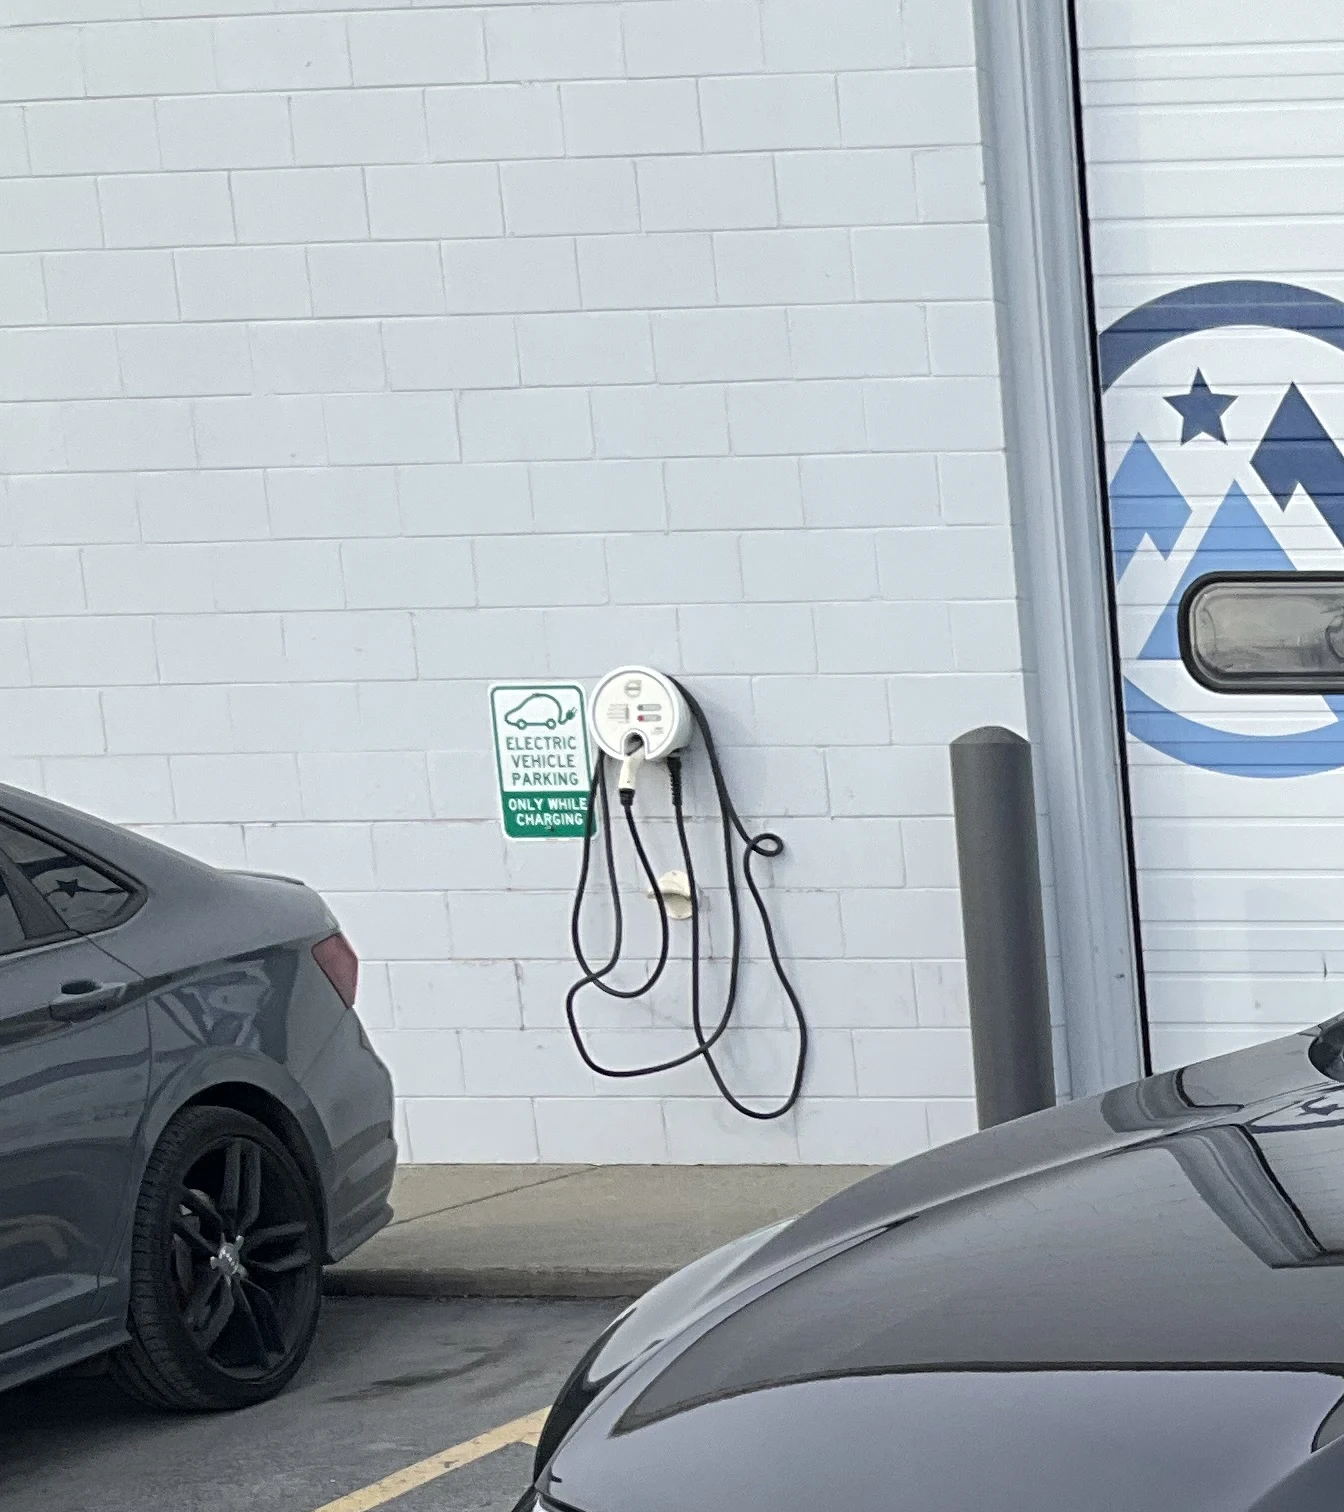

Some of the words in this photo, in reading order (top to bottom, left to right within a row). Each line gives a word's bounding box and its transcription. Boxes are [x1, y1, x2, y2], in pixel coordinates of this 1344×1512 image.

[506, 736, 577, 751] ELECTRIC
[510, 754, 577, 769] VEHICLE
[512, 772, 579, 787] PARKING
[508, 798, 543, 811] ONLY
[548, 797, 588, 811] WHILE
[516, 813, 584, 827] CHARGING
